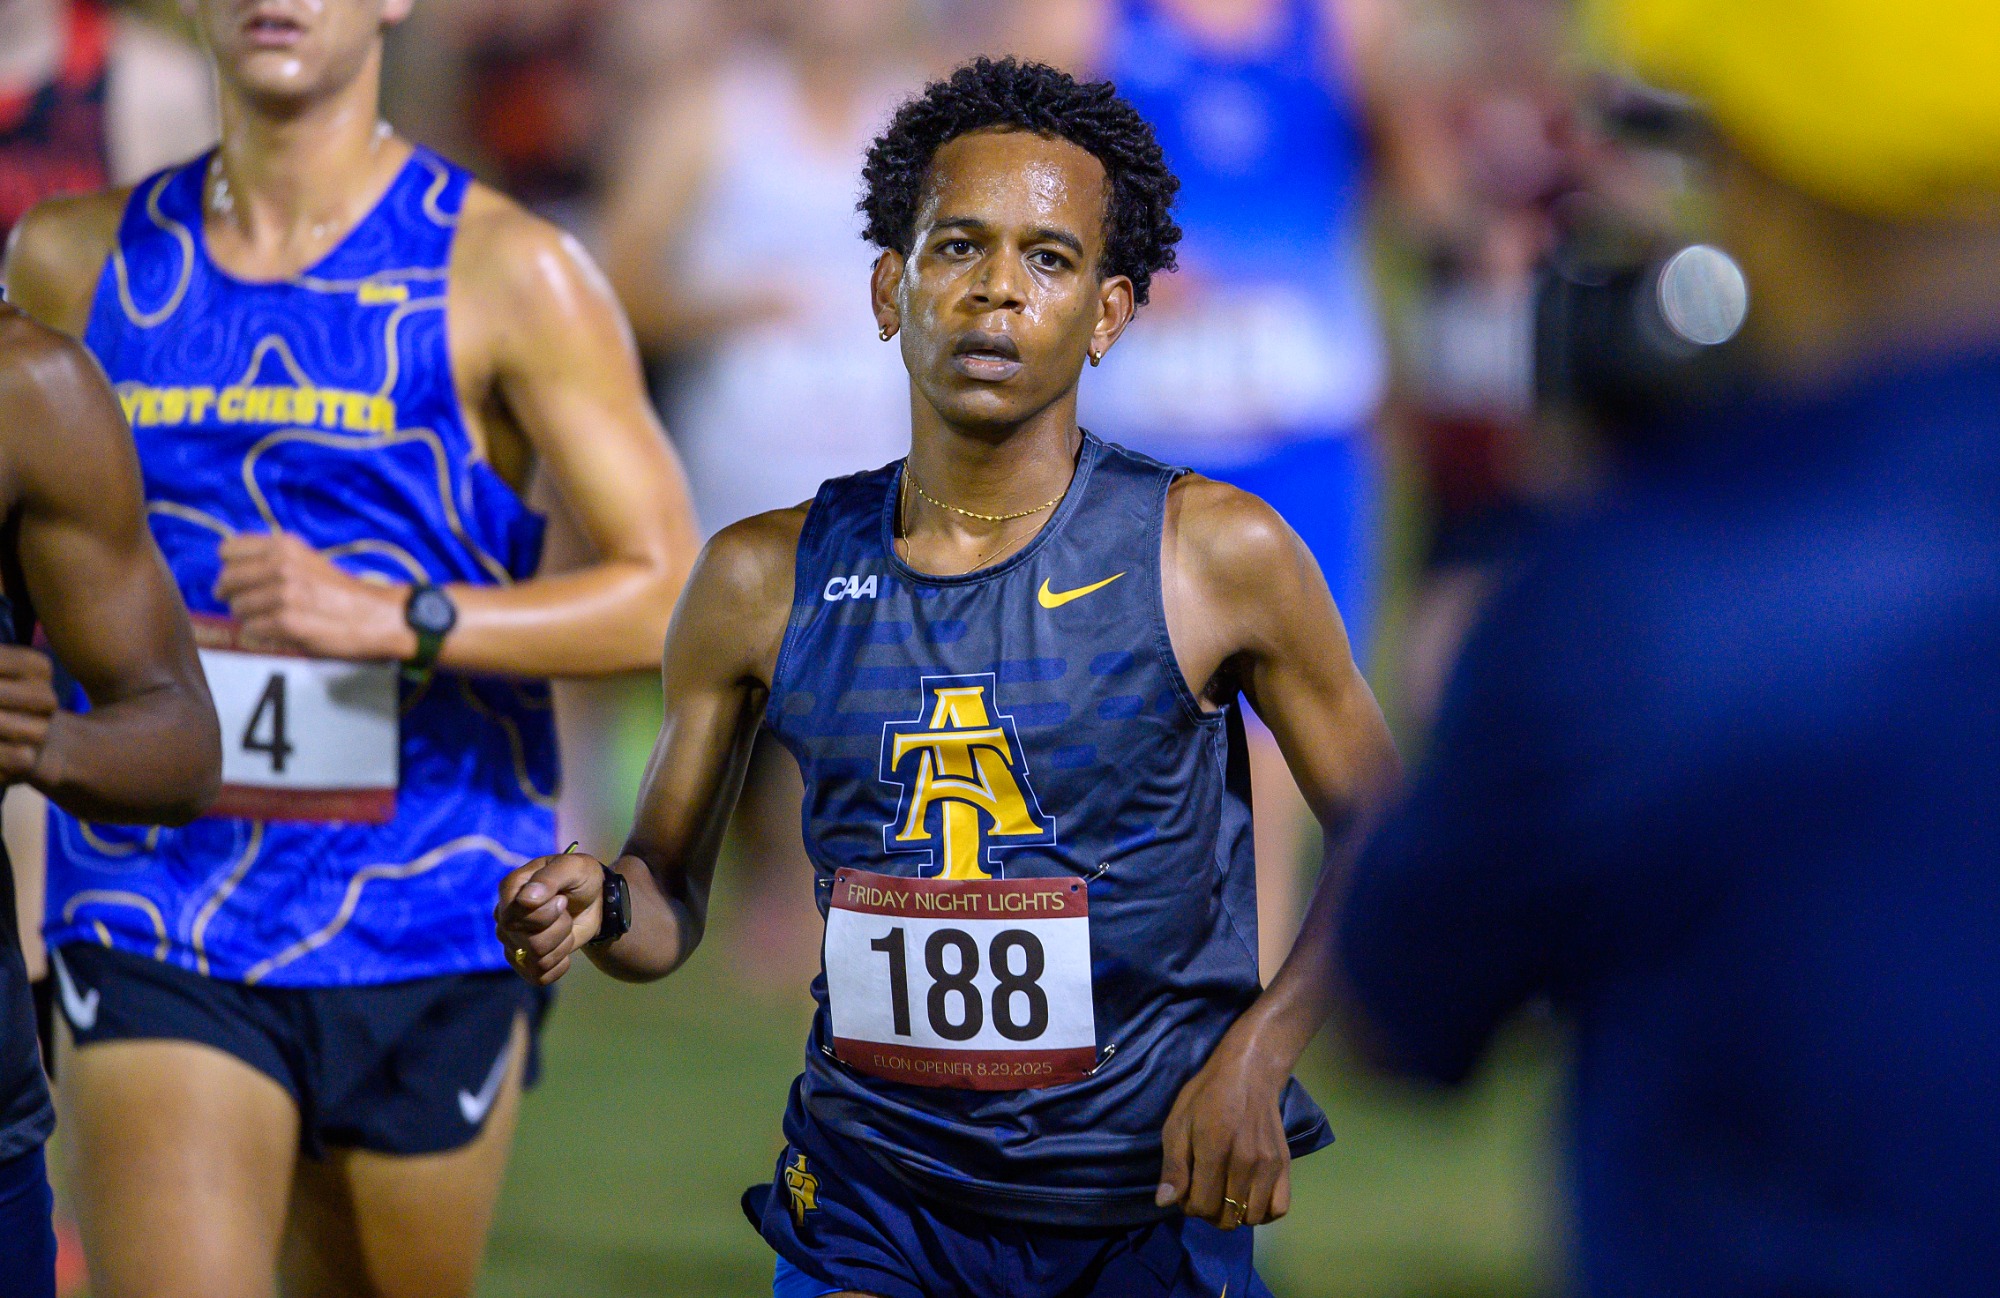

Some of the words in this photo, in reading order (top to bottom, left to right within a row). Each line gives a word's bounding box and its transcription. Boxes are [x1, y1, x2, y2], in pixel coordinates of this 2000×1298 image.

[823, 574, 878, 602] CAA
[241, 673, 293, 773] 4
[848, 884, 909, 909] FRIDAY
[915, 891, 982, 912] NIGHT
[987, 891, 1065, 912] LIGHTS
[870, 926, 1049, 1042] 188
[873, 1054, 911, 1071] ELON
[914, 1059, 973, 1076] OPENER
[976, 1062, 1053, 1077] 8.29.2025
